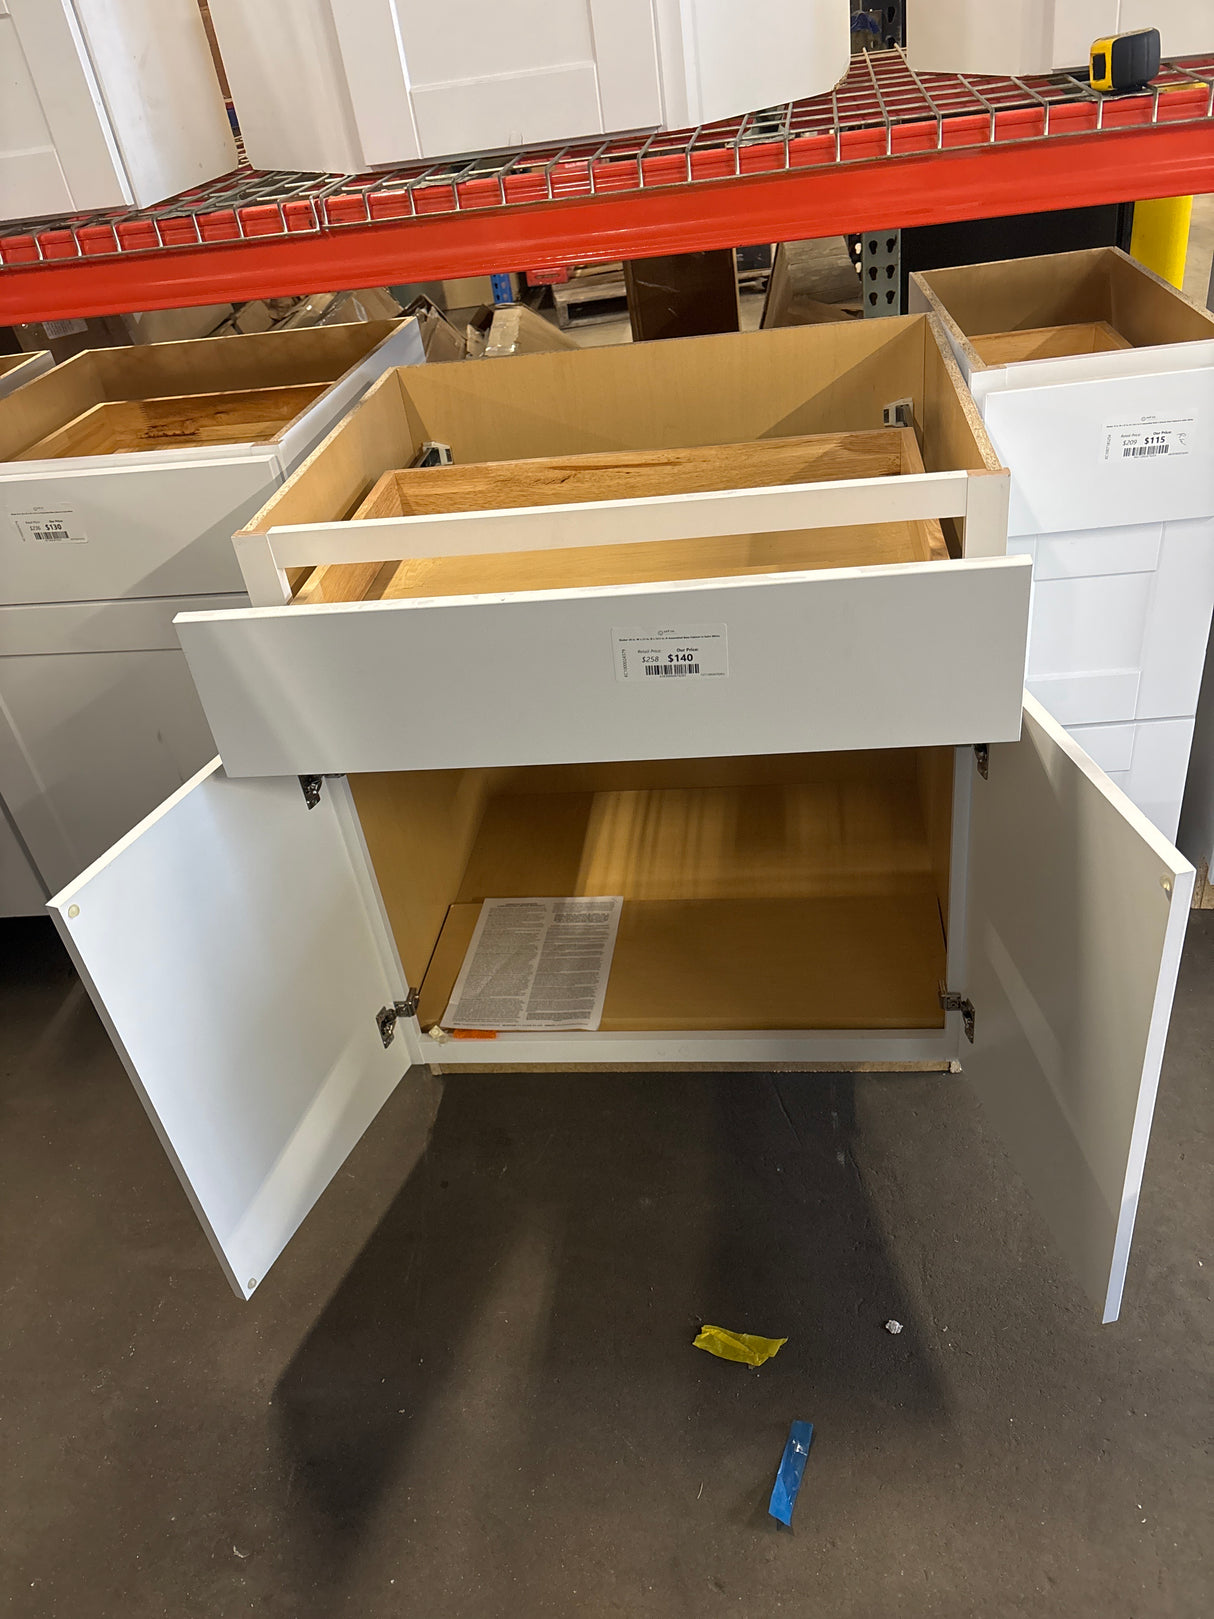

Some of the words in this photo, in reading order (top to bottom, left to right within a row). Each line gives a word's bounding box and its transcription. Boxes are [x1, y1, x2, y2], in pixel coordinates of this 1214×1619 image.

[1144, 436, 1166, 445] $115
[45, 523, 62, 531] $130
[641, 655, 660, 663] $258
[667, 653, 694, 663] $140
